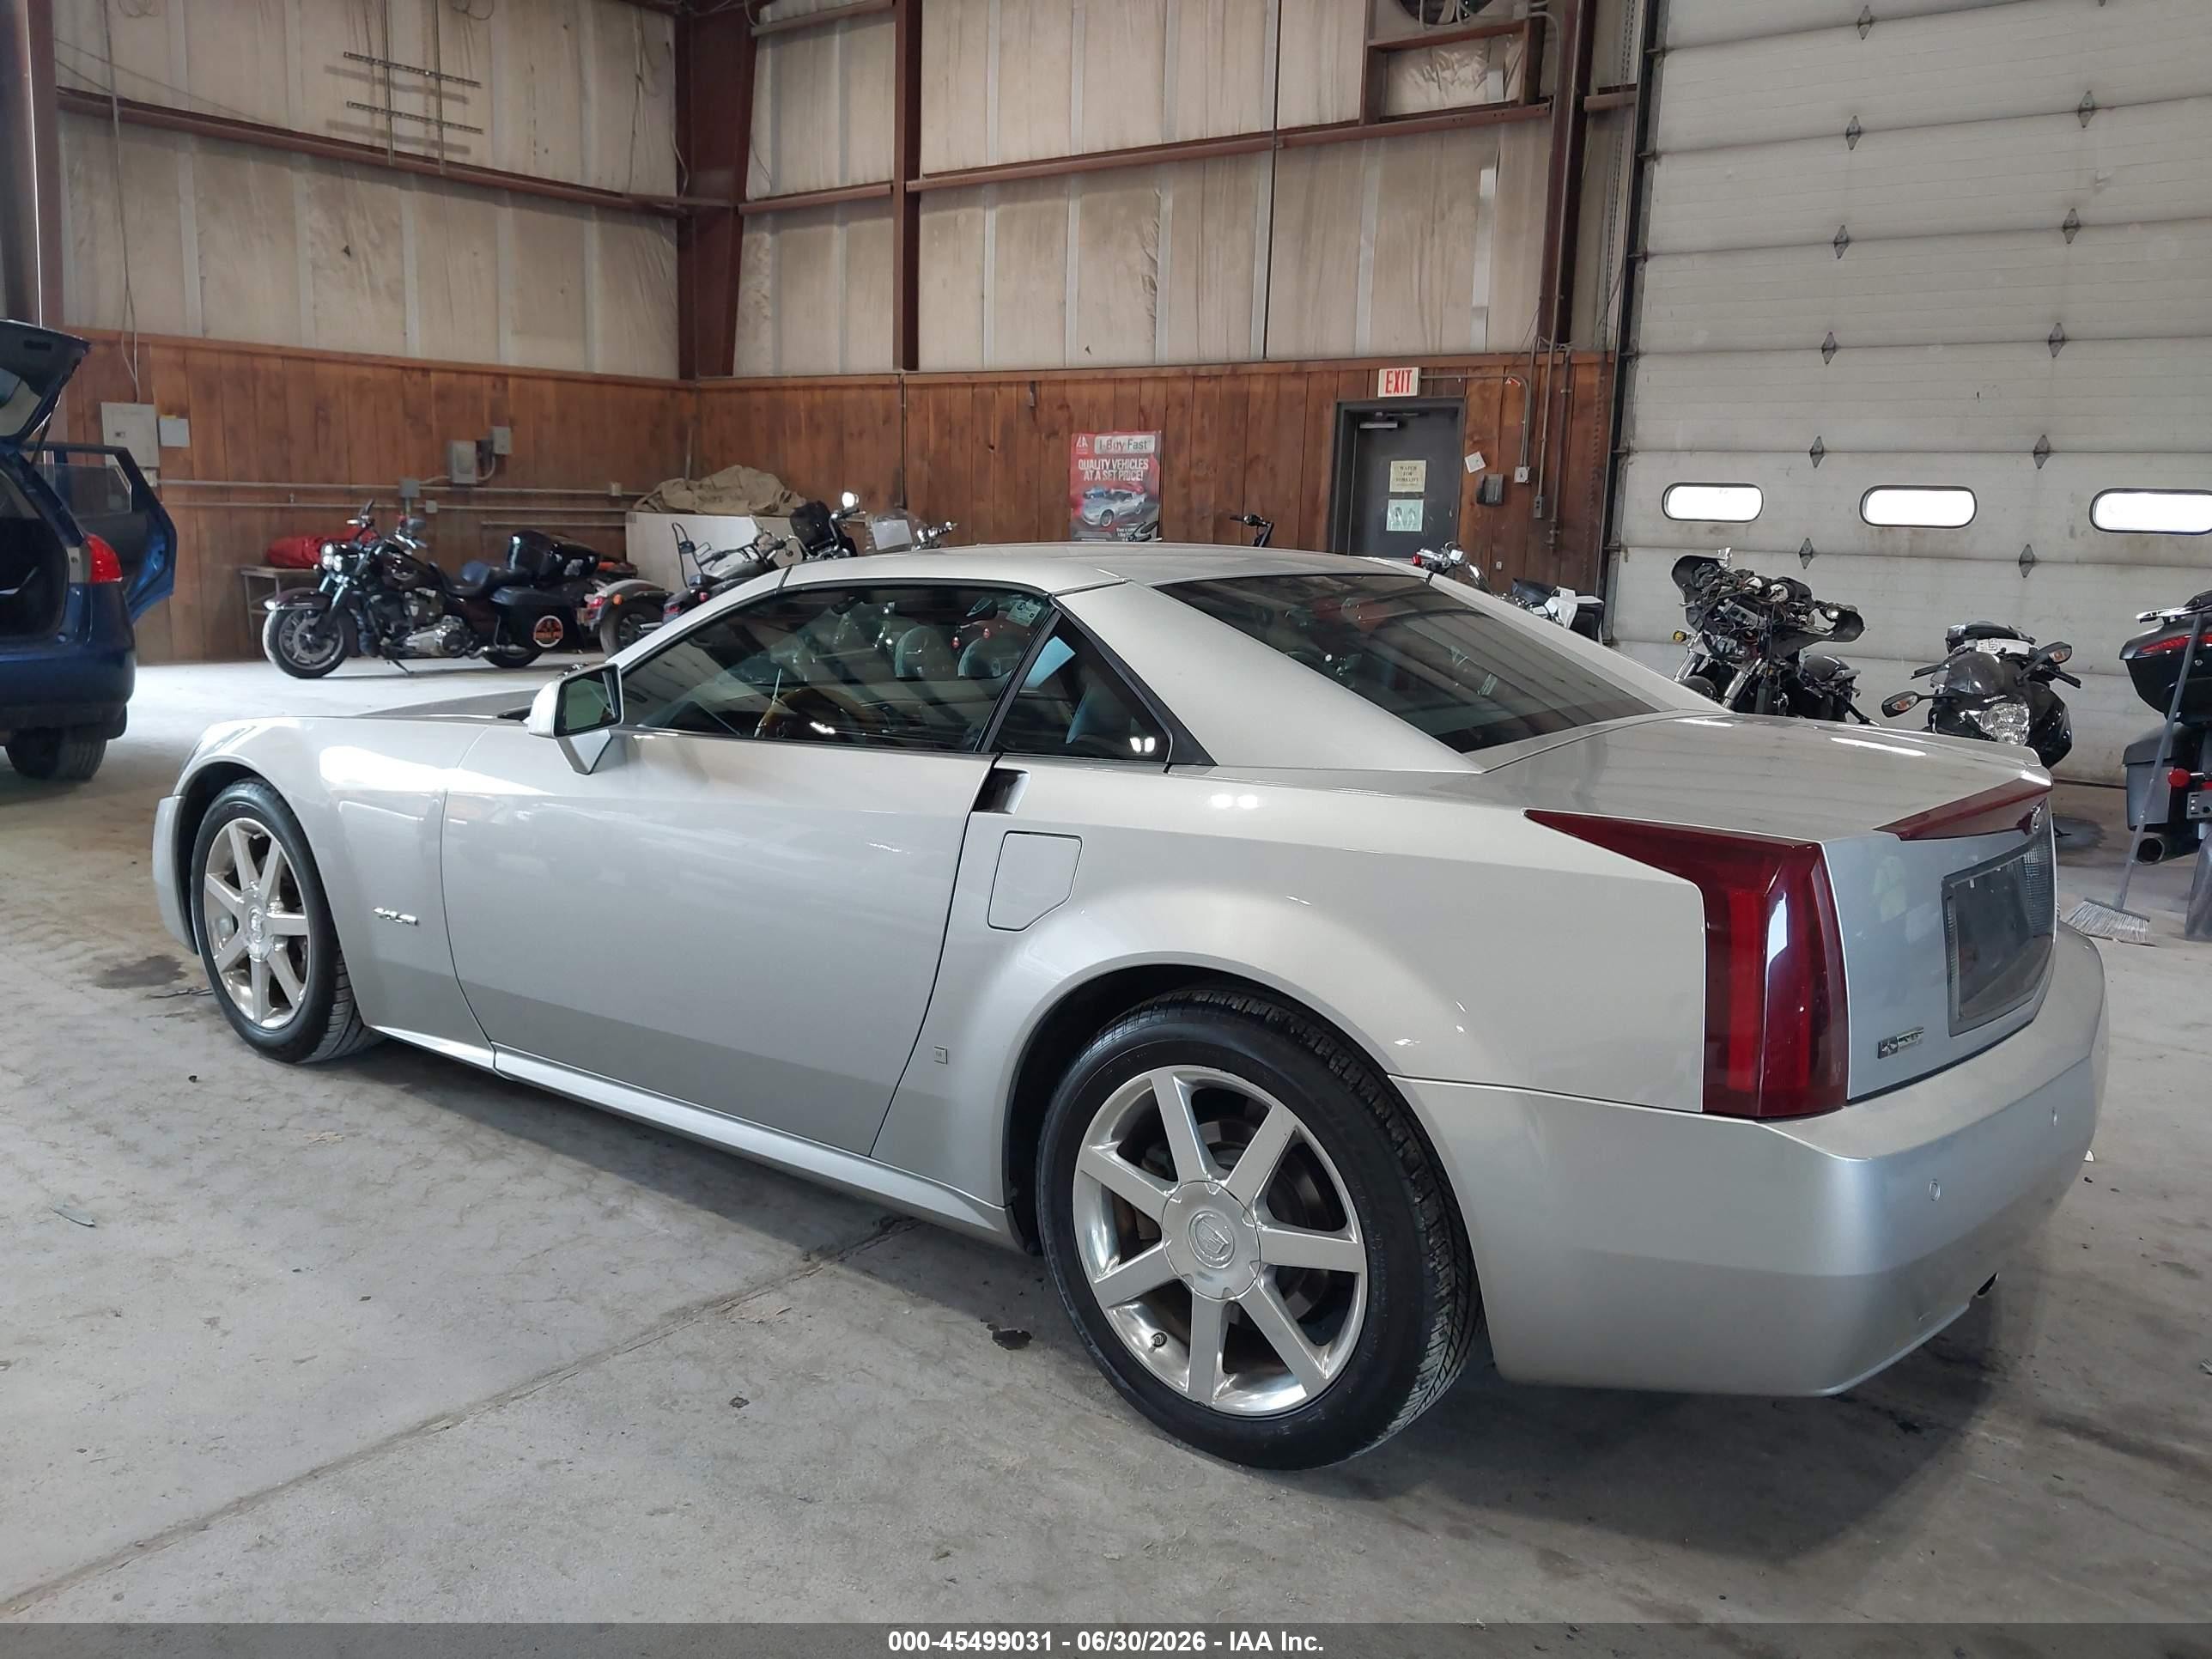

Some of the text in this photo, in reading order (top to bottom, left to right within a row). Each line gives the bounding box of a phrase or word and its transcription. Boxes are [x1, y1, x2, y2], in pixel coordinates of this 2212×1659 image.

[1385, 369, 1412, 393] EXIT
[1127, 437, 1148, 450] Fast
[1079, 458, 1149, 471] QUALITY VEHICLES
[1084, 470, 1144, 481] AT A SET PRICE!
